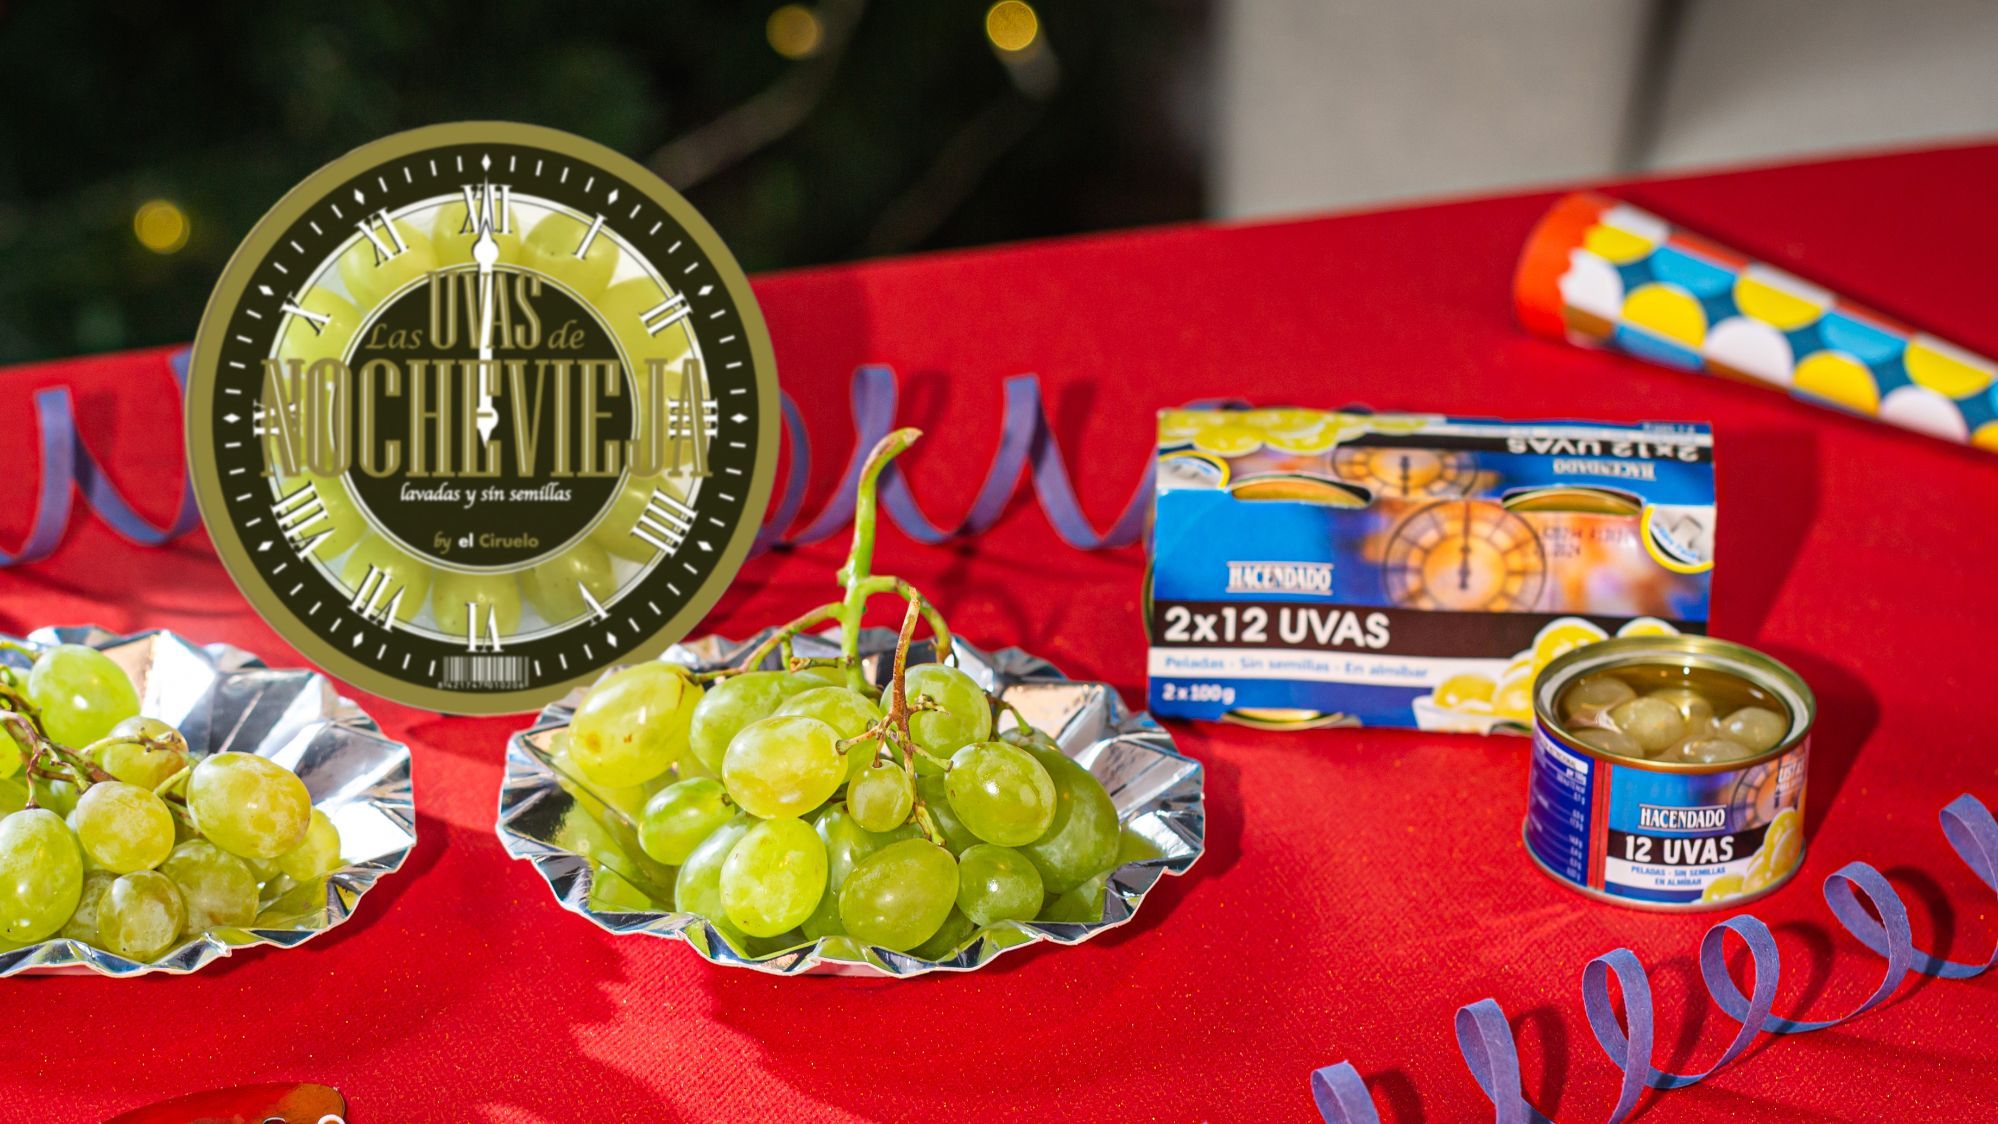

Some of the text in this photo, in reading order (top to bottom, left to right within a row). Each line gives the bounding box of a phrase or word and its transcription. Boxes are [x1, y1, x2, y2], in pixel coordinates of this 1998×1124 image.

[365, 271, 585, 350] Las UVAS de
[260, 357, 713, 479] NOCHEVIEJA
[1506, 436, 1603, 456] UVAS
[1553, 458, 1656, 481] HACENDADO
[400, 482, 572, 509] lavadas y sin semillas
[433, 532, 539, 554] by el Ciruelo
[1228, 563, 1332, 593] HACENDADO
[1164, 606, 1390, 648] 2x12 UVAS
[1164, 655, 1224, 670] Peladas
[1240, 657, 1263, 670] Sin
[1269, 658, 1329, 672] semillas
[1345, 662, 1364, 675] En
[1640, 807, 1726, 828] HACENDADO
[1625, 835, 1735, 865] 12 UVAS
[1631, 866, 1666, 876] PELADAS
[1674, 868, 1687, 877] SIN
[1689, 866, 1726, 876] SEMILLAS
[1655, 878, 1666, 886] EN
